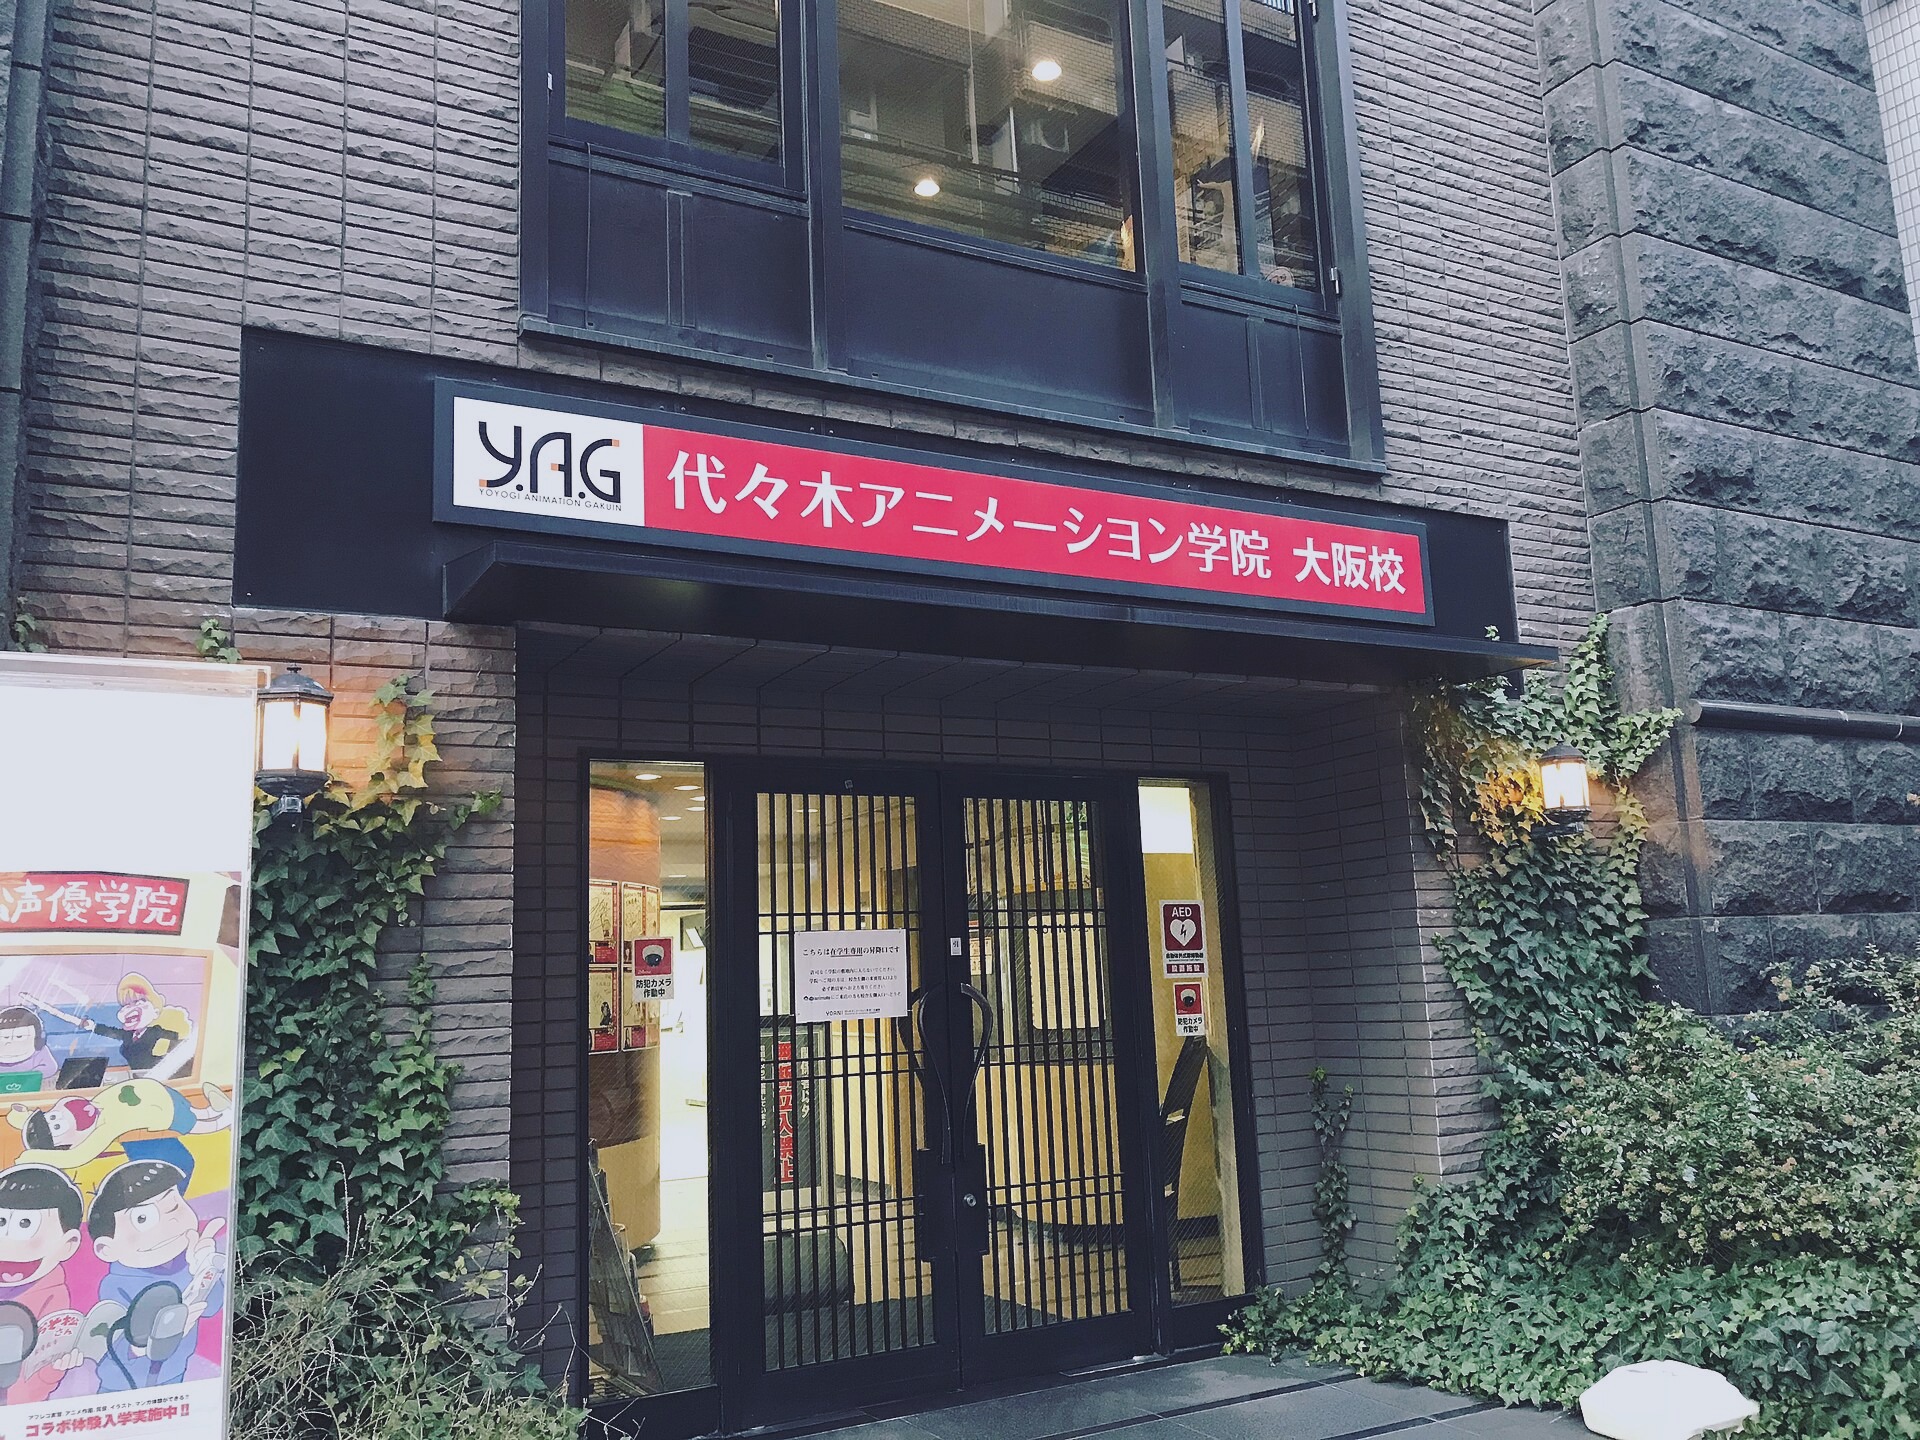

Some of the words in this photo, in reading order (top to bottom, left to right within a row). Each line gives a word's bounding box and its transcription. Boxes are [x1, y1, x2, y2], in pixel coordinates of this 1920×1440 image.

[479, 488, 521, 500] YOYOGI
[524, 493, 581, 507] ANIMATION
[585, 500, 622, 512] GAKUIN
[1293, 537, 1407, 595] 大阪校
[1171, 906, 1192, 918] AED
[636, 978, 672, 989] 防犯カメラ
[643, 988, 666, 998] 作動中
[1177, 1016, 1203, 1026] 防犯カメラ
